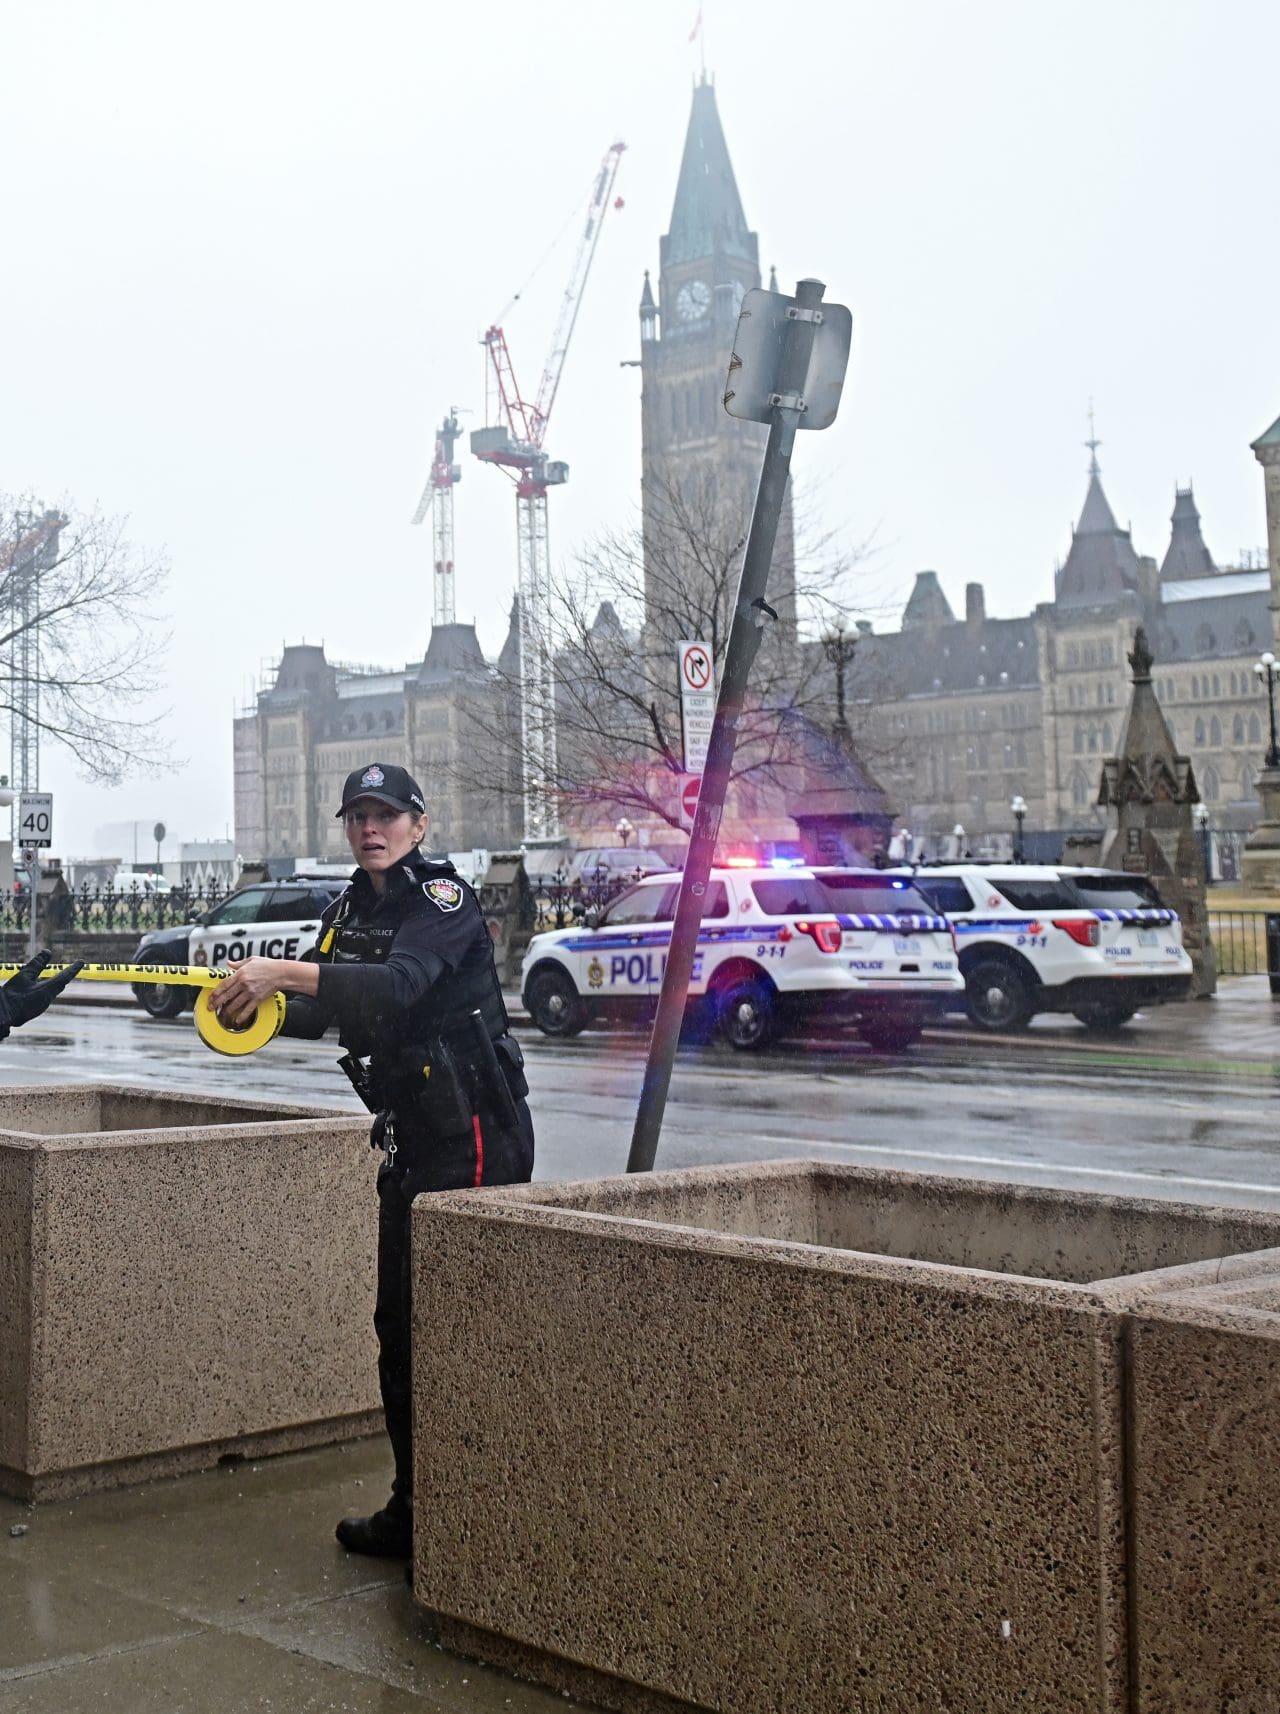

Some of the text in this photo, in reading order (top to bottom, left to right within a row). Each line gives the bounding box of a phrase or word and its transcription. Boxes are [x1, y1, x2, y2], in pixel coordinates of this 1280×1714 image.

[23, 813, 49, 832] 40
[213, 938, 300, 966] POLICE
[849, 961, 884, 969] POLICE
